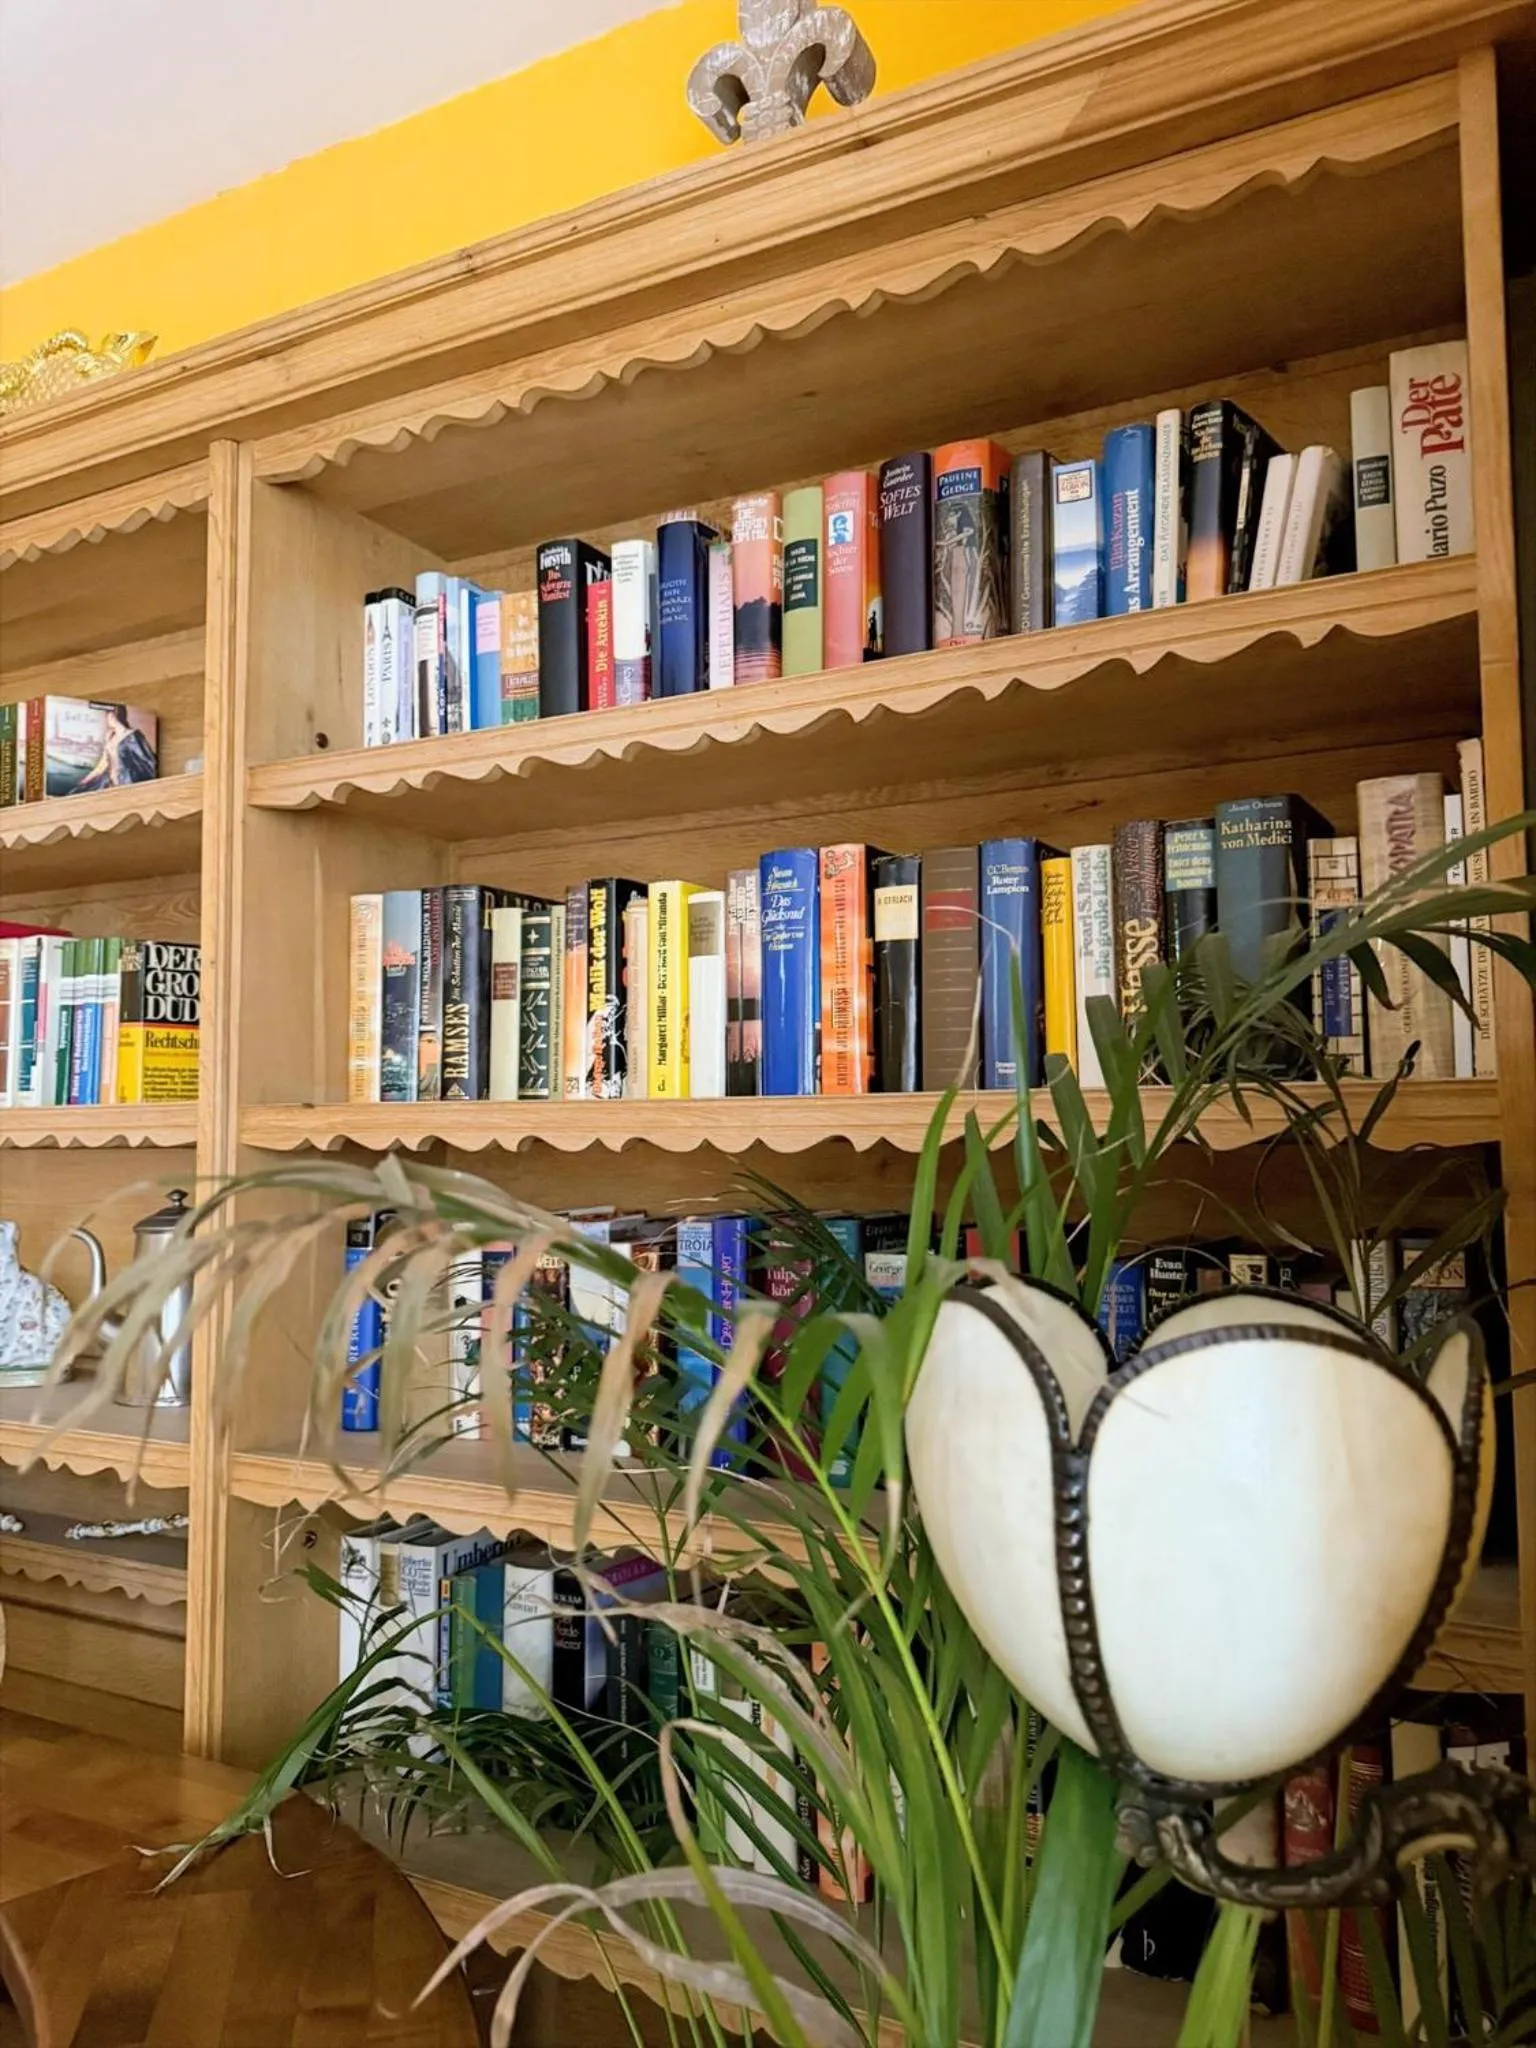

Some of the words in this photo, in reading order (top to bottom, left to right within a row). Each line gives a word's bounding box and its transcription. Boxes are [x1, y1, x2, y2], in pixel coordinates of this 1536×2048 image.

[1401, 377, 1432, 434] Der
[1420, 372, 1466, 460] Pate
[880, 484, 922, 509] SOFIES
[1424, 464, 1449, 514] Puzo
[883, 501, 917, 523] WELT
[1123, 488, 1145, 594] Arrangement
[1425, 514, 1450, 559] ario
[365, 647, 376, 707] LONDON
[381, 642, 393, 683] PARIS
[595, 648, 609, 672] Die
[1466, 769, 1479, 810] BARDO
[1220, 817, 1292, 836] Katharina
[1221, 838, 1245, 850] von
[1246, 832, 1293, 847] Medici
[986, 884, 1029, 897] Lampion
[1092, 850, 1108, 896] Liebe
[771, 895, 790, 908] Das
[590, 928, 607, 958] der
[1079, 914, 1093, 957] Pearl
[146, 969, 199, 997] GRO
[1095, 952, 1109, 980] Die
[1476, 966, 1490, 1018] SCHÄTZE
[443, 1002, 470, 1080] RAMSES
[1150, 1267, 1189, 1280] Hunter
[1155, 1258, 1182, 1270] Evan
